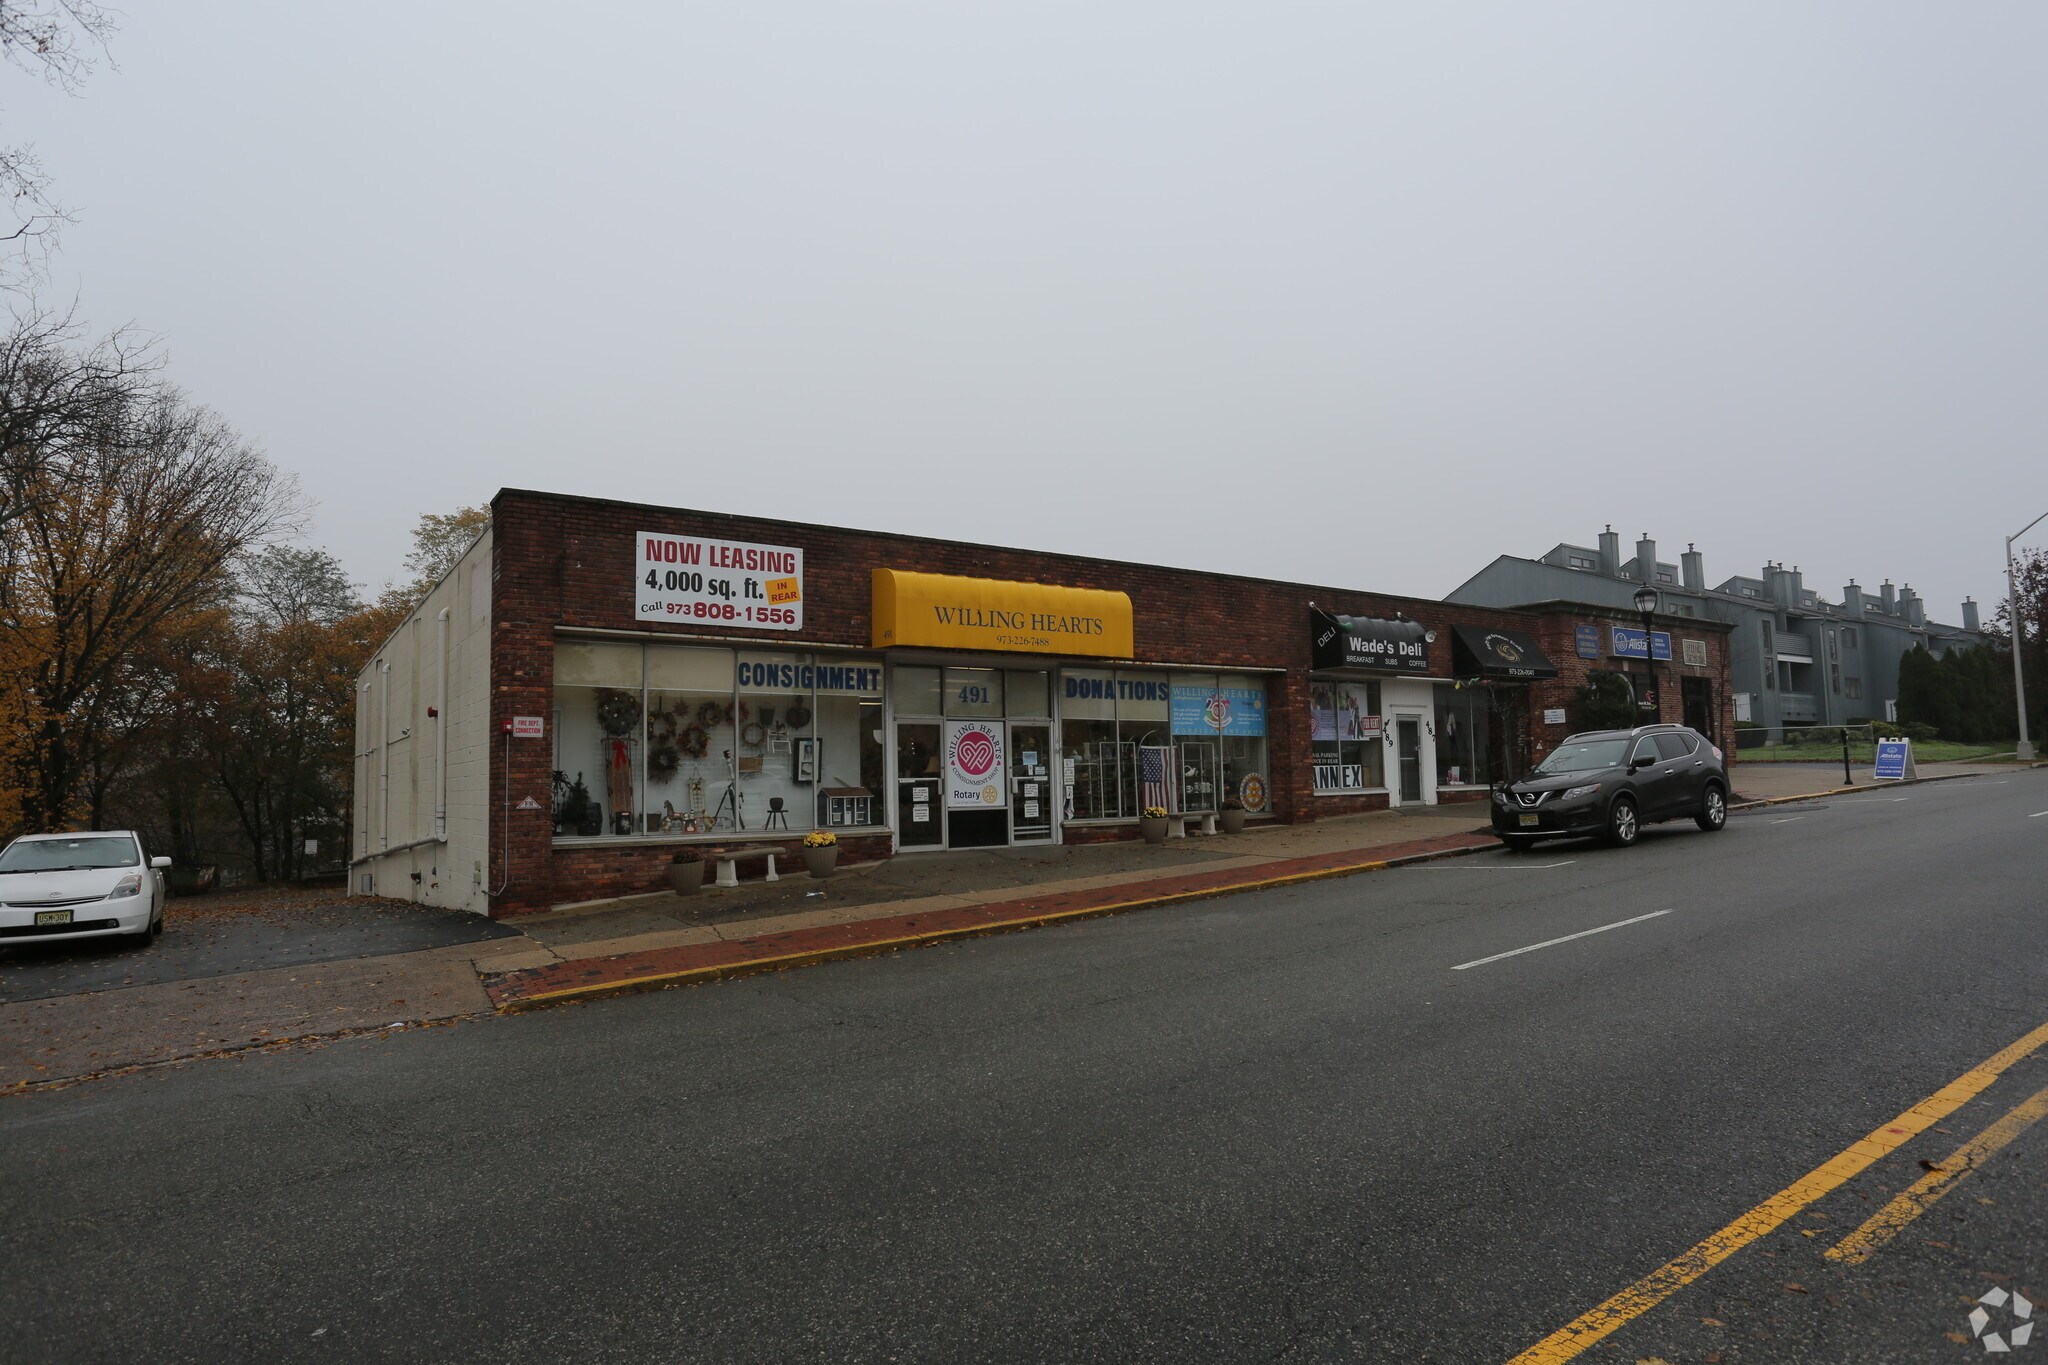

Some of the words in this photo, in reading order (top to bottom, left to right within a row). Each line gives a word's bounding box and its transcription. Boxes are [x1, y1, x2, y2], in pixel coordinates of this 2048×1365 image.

[646, 539, 702, 565] NOW
[710, 545, 795, 574] LEASING
[645, 569, 703, 593] 4,000
[708, 578, 736, 600] sq.
[744, 577, 764, 599] ft.
[776, 581, 787, 591] IN
[771, 591, 798, 602] REAR
[641, 601, 663, 613] Call
[666, 602, 691, 615] 973
[693, 602, 796, 625] 808-1556
[934, 605, 1025, 630] WILLING
[1030, 613, 1103, 636] HEARTS
[996, 635, 1050, 647] 973-226-7488
[1317, 626, 1336, 648] DELI
[1349, 636, 1395, 655] Wade's
[1399, 641, 1422, 657] Deli
[1628, 637, 1653, 651] Allsta
[1346, 655, 1375, 665] BREAKFAST
[1385, 658, 1398, 666] SUBS
[1408, 659, 1427, 668] COFFEE
[738, 661, 880, 691] CONSIGNMENT
[958, 686, 990, 704] 491
[1066, 677, 1169, 701] DONATIONS
[1172, 688, 1214, 697] WILLING
[1223, 689, 1262, 699] HEARTS
[1383, 727, 1394, 747] 489
[1425, 720, 1436, 742] 487
[949, 723, 975, 760] WILLING
[979, 724, 1002, 760] HEARTS
[952, 767, 988, 785] CONSIGNMENT
[987, 767, 999, 781] SHOP
[953, 790, 980, 801] Rotary
